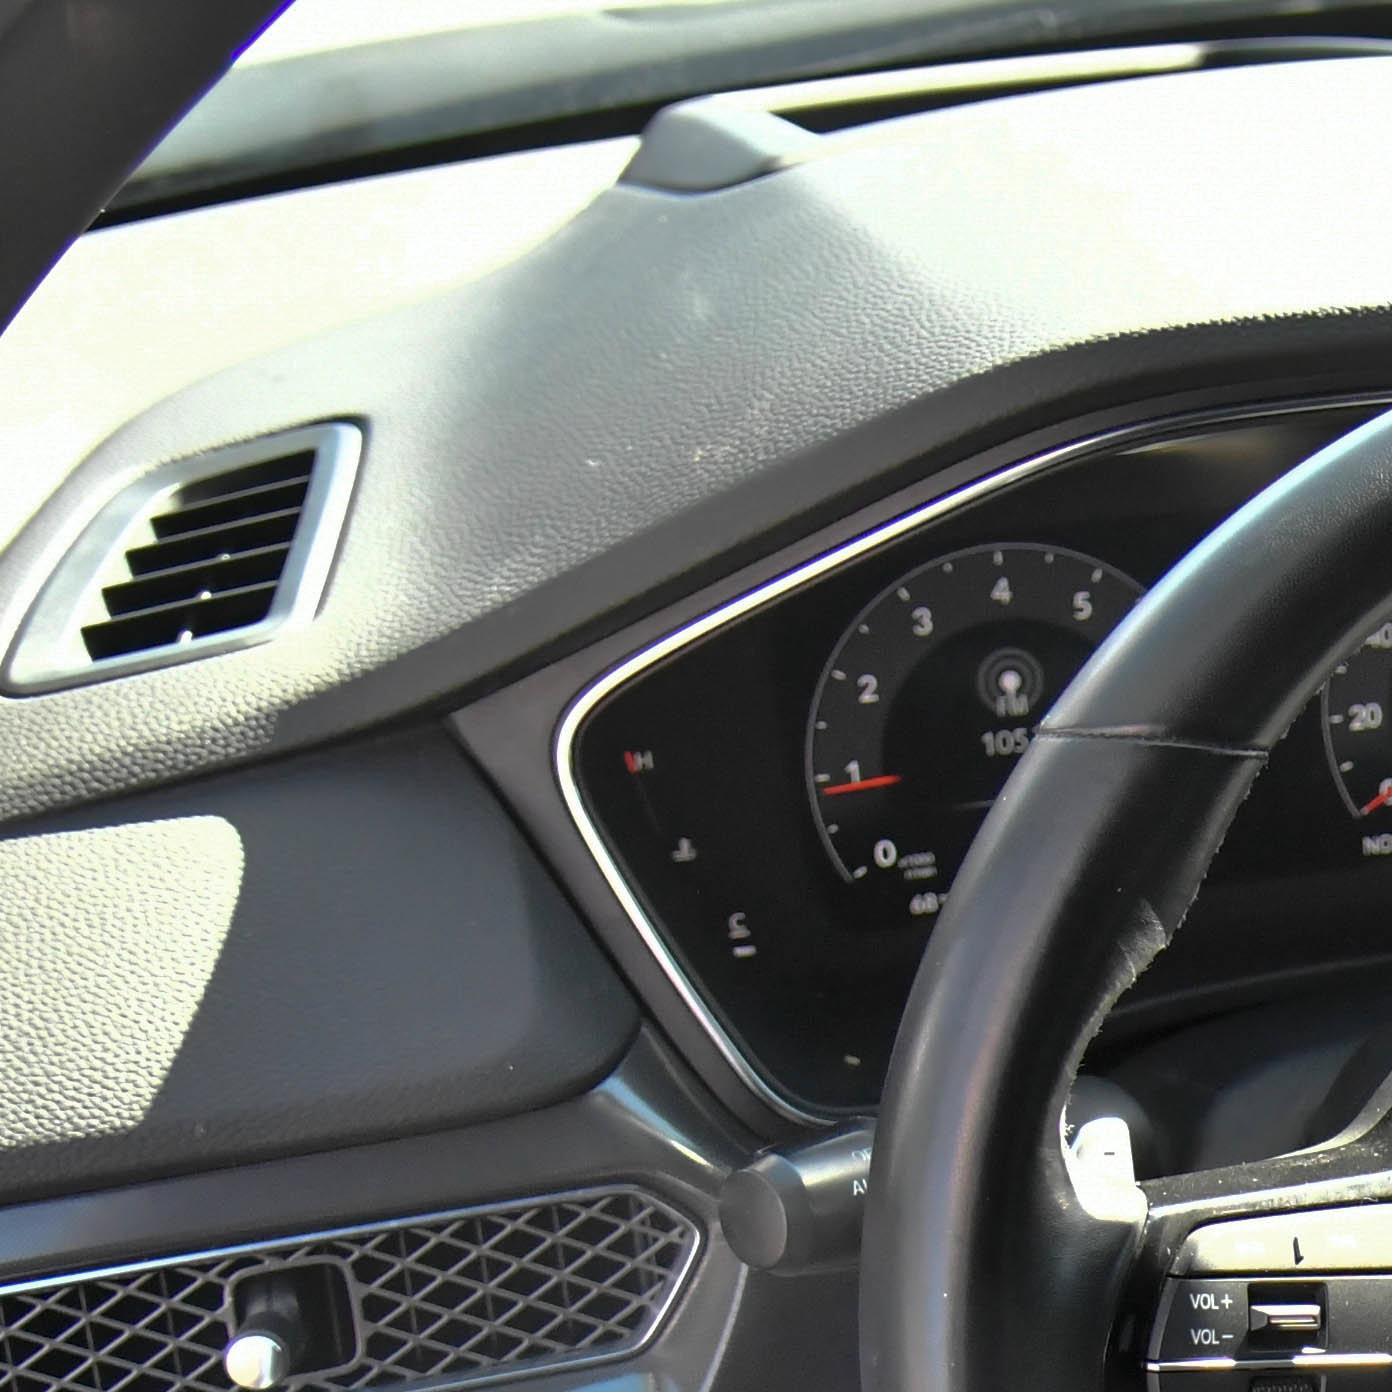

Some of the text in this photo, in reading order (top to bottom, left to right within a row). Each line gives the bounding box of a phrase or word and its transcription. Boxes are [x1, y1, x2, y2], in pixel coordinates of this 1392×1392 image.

[990, 577, 1012, 605] 4
[1072, 591, 1093, 621] 5
[910, 606, 935, 637] 3
[856, 673, 880, 704] 2
[1348, 701, 1383, 732] 20
[845, 760, 862, 785] 1
[871, 837, 898, 868] 0
